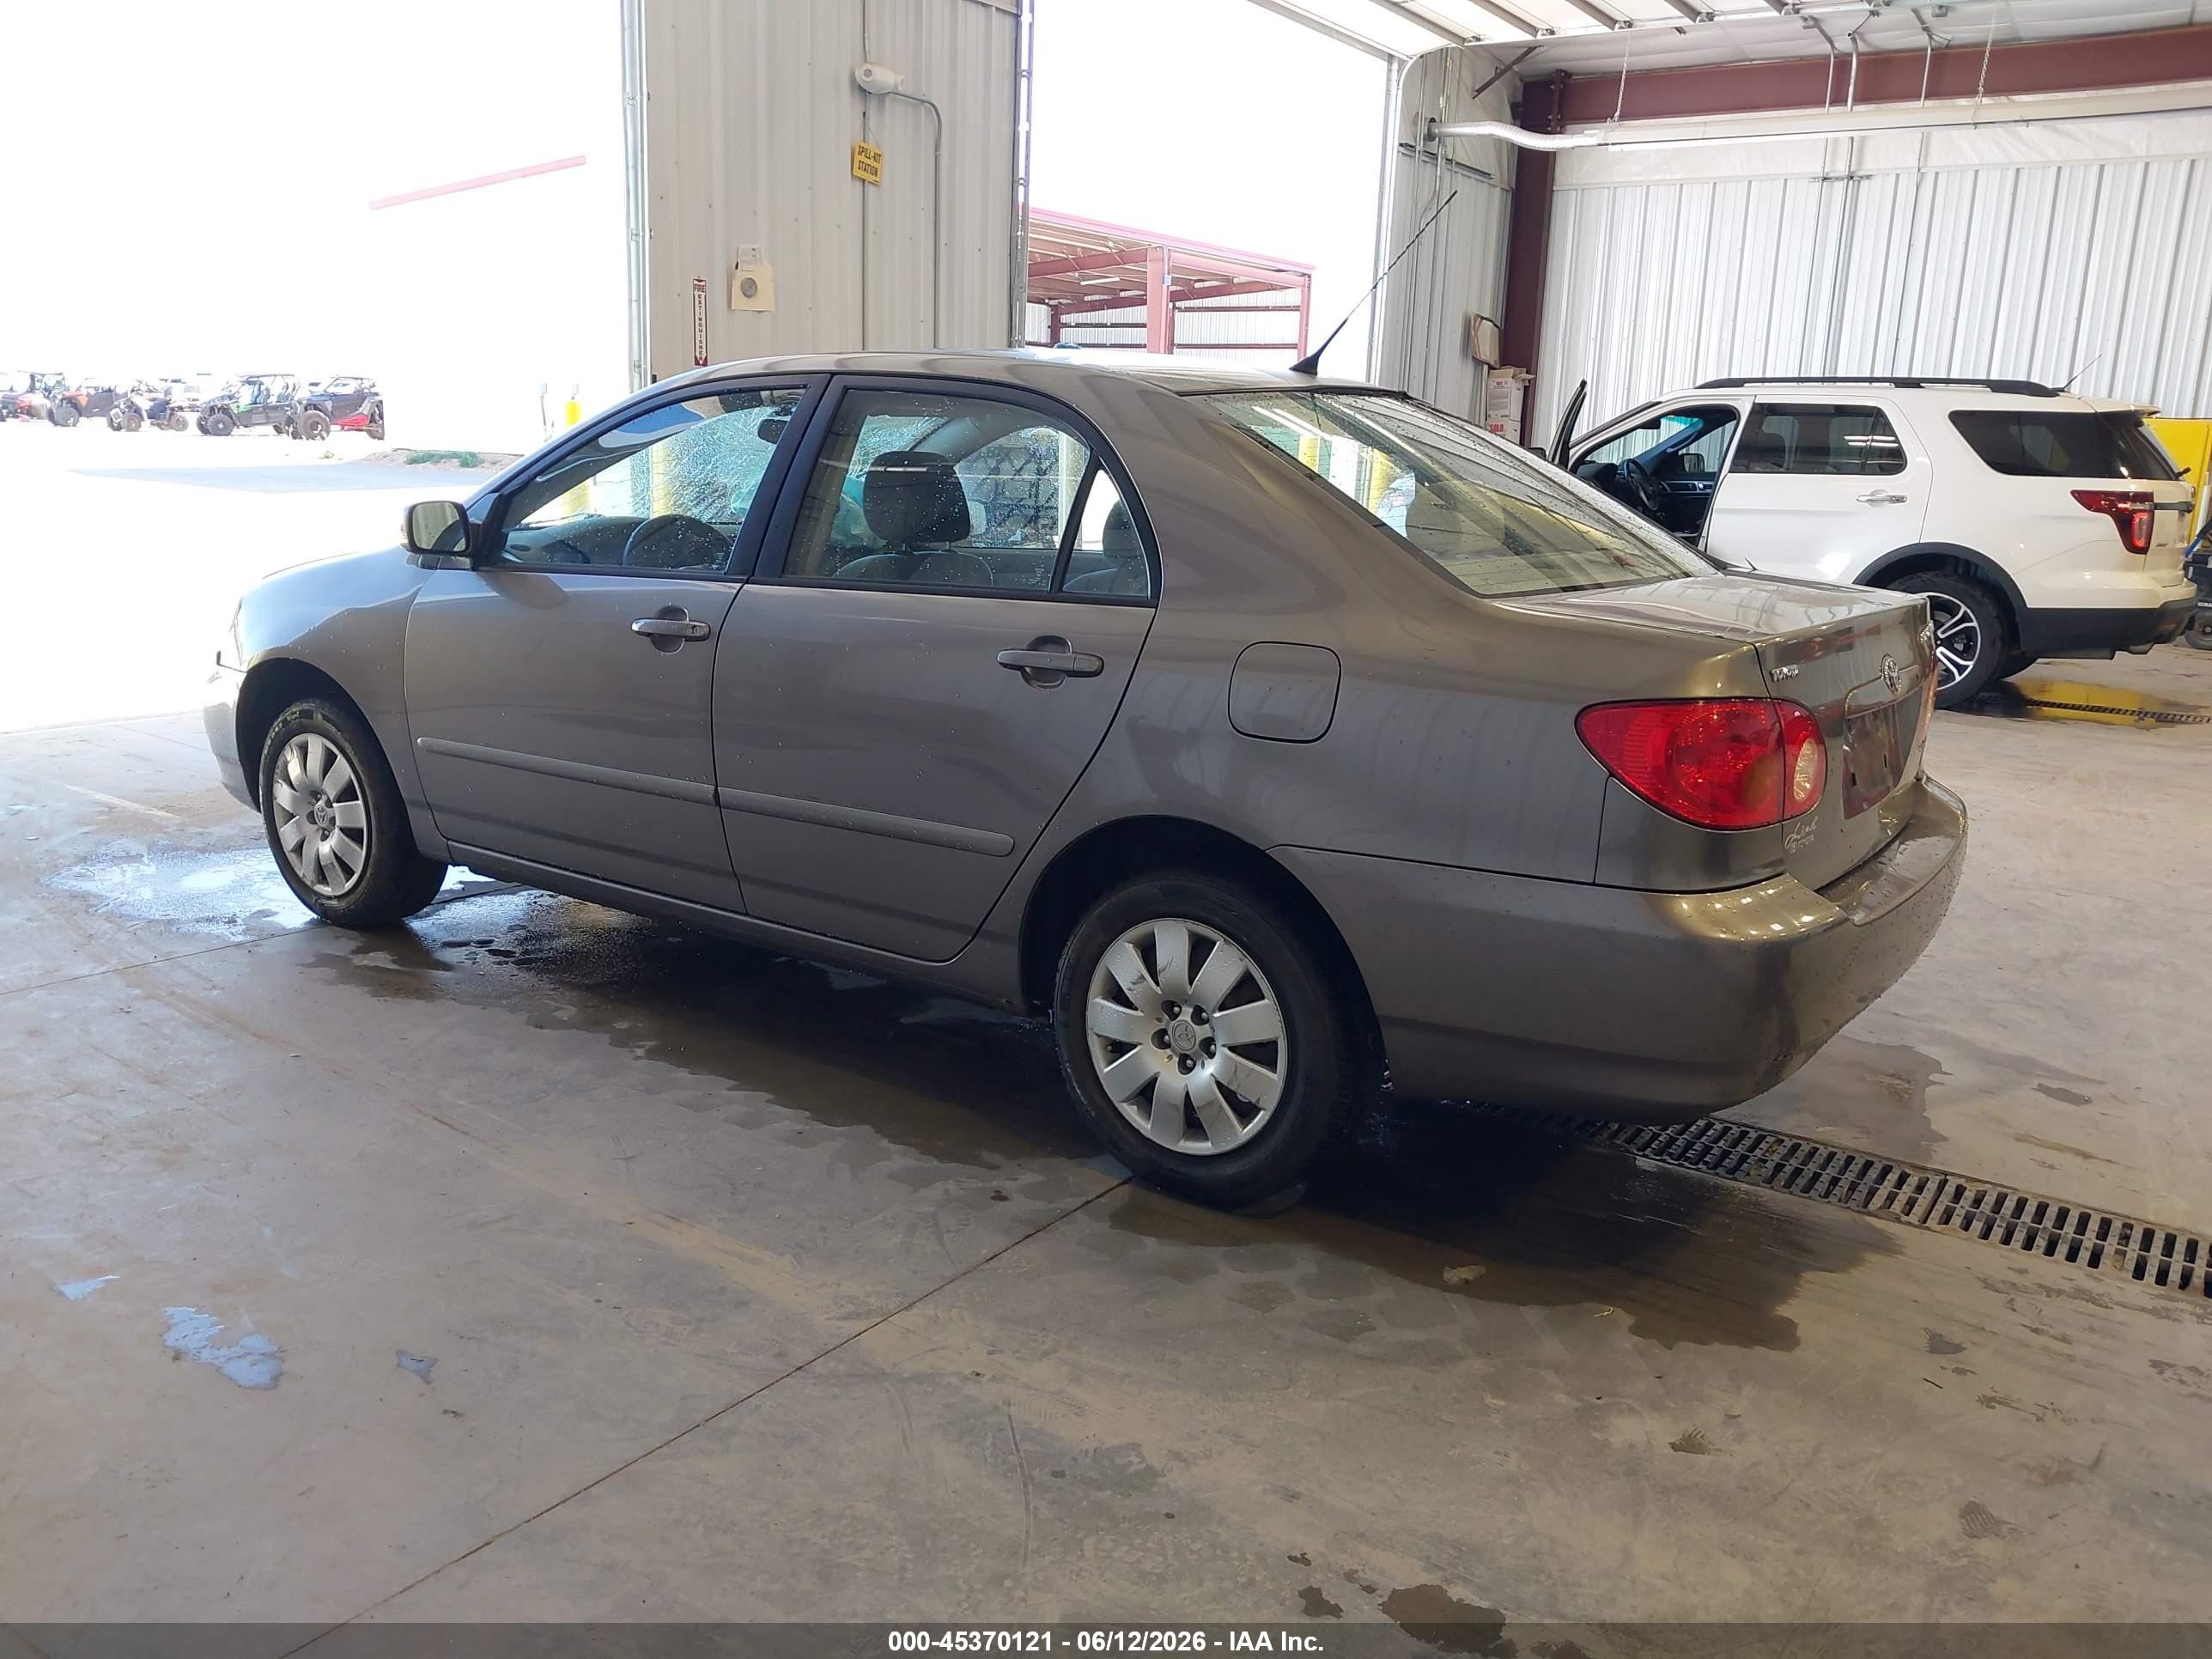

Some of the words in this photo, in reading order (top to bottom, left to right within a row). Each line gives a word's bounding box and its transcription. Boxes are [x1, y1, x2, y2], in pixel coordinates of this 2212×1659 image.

[857, 144, 881, 164] SPILL-KIT
[857, 159, 878, 177] STATION
[694, 283, 706, 293] FIRE
